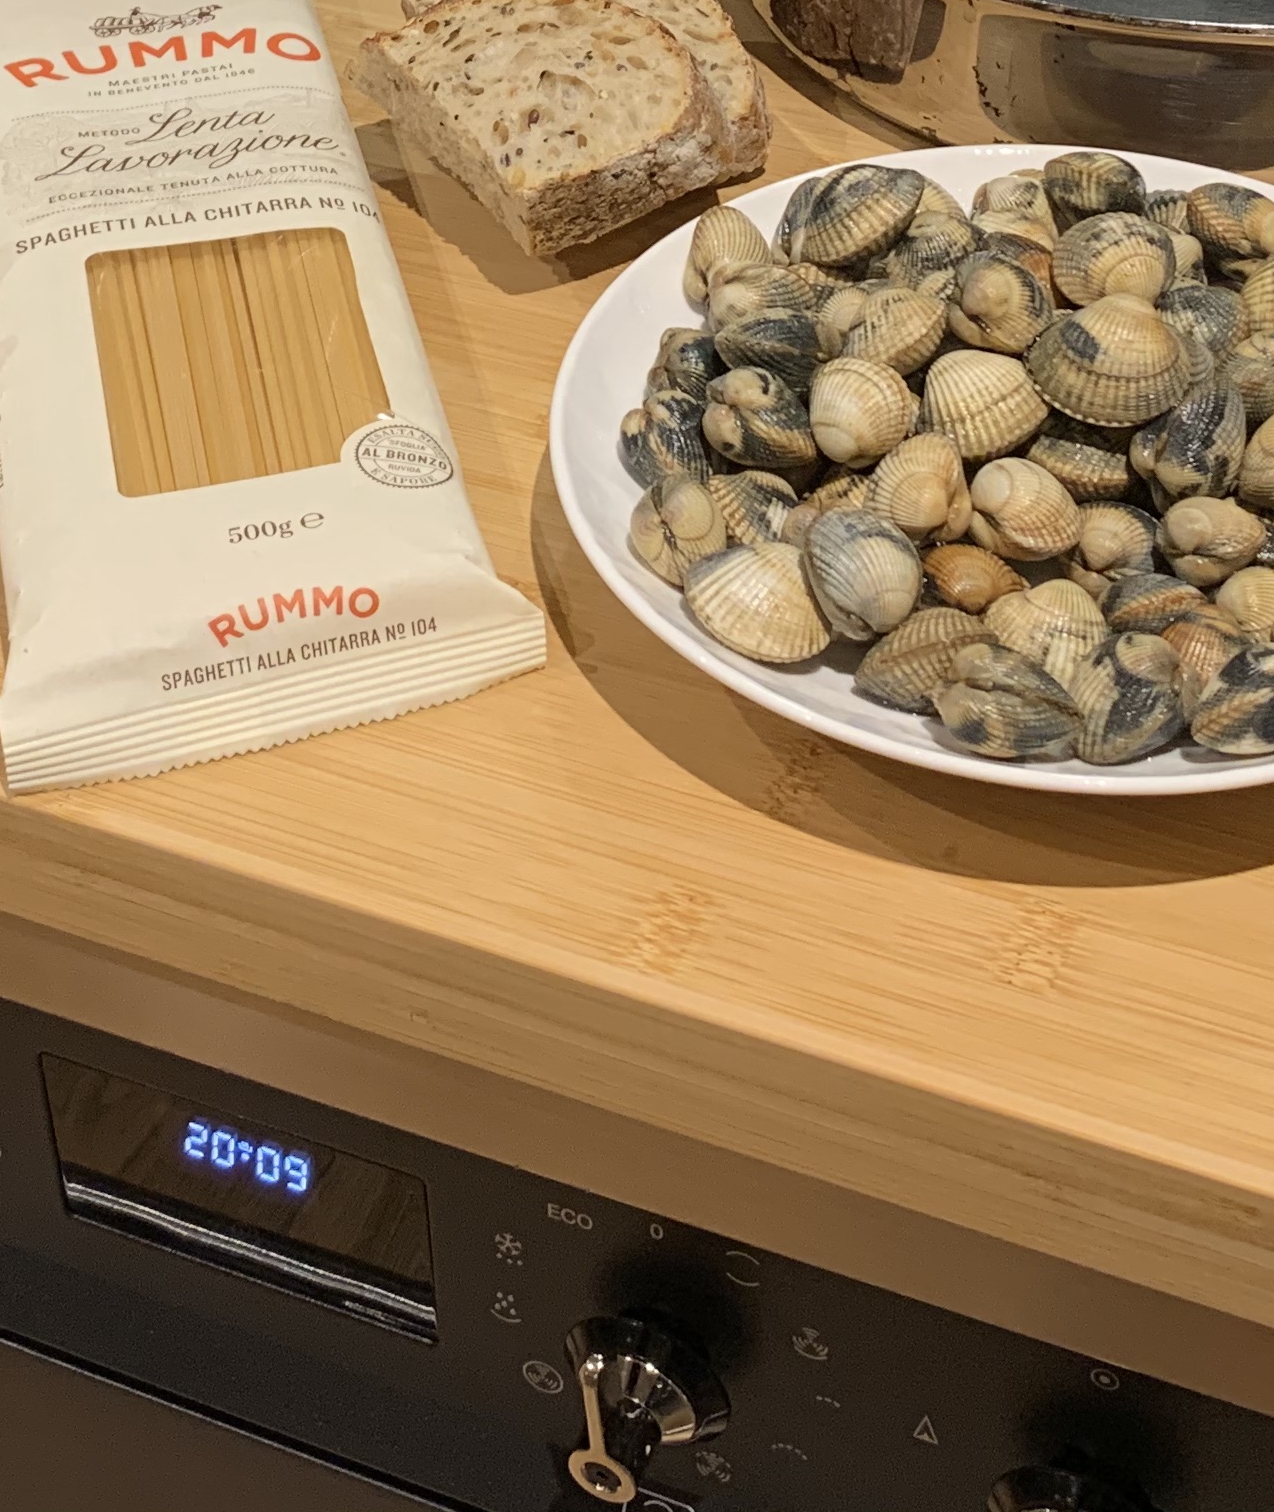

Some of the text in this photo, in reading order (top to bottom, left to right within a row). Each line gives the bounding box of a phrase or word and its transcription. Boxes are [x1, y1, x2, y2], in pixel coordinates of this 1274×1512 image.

[3, 27, 322, 88] RUMMO
[108, 62, 234, 88] MAESTRI PASTAI
[87, 90, 103, 98] IN
[108, 79, 189, 97] BENEVENTO
[195, 75, 221, 85] DAL
[77, 107, 276, 145] METODO Lenta
[48, 164, 339, 204] ECCEZIONALE TENUTA ALLA COTTURA
[15, 217, 136, 255] SPAGHETTI
[144, 211, 197, 228] ALLA
[204, 196, 313, 221] CHITARRA
[361, 447, 447, 470] AL BRONZO
[227, 520, 294, 544] 500g
[207, 585, 380, 648] RUMMO
[161, 655, 252, 691] SPAGHETTI
[257, 647, 296, 670] ALLA
[300, 628, 381, 660] CHITARRA
[411, 616, 438, 637] 104
[184, 1121, 309, 1192] 20:09
[547, 1202, 593, 1230] ECO
